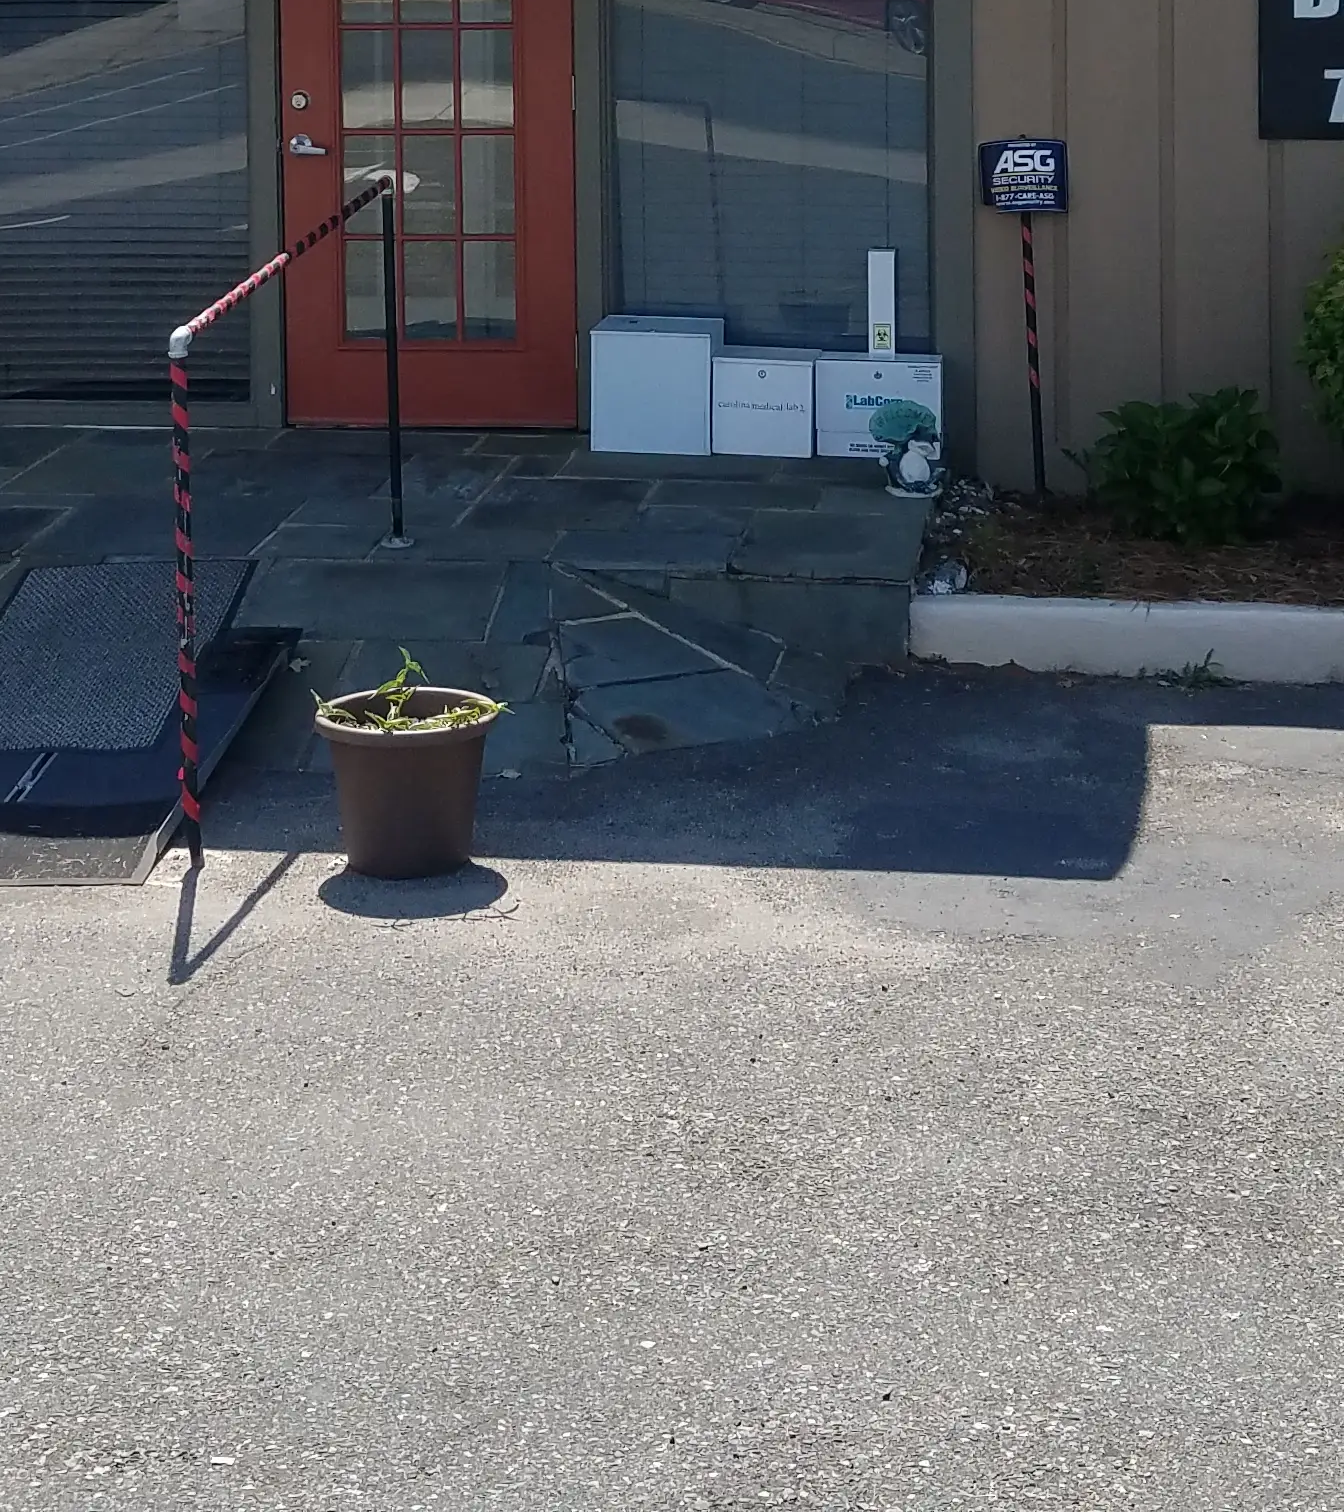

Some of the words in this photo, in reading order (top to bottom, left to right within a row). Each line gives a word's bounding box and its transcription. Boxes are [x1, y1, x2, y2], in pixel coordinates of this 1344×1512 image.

[994, 149, 1055, 174] ASG
[993, 176, 1054, 185] SECURITY
[752, 402, 783, 411] medical
